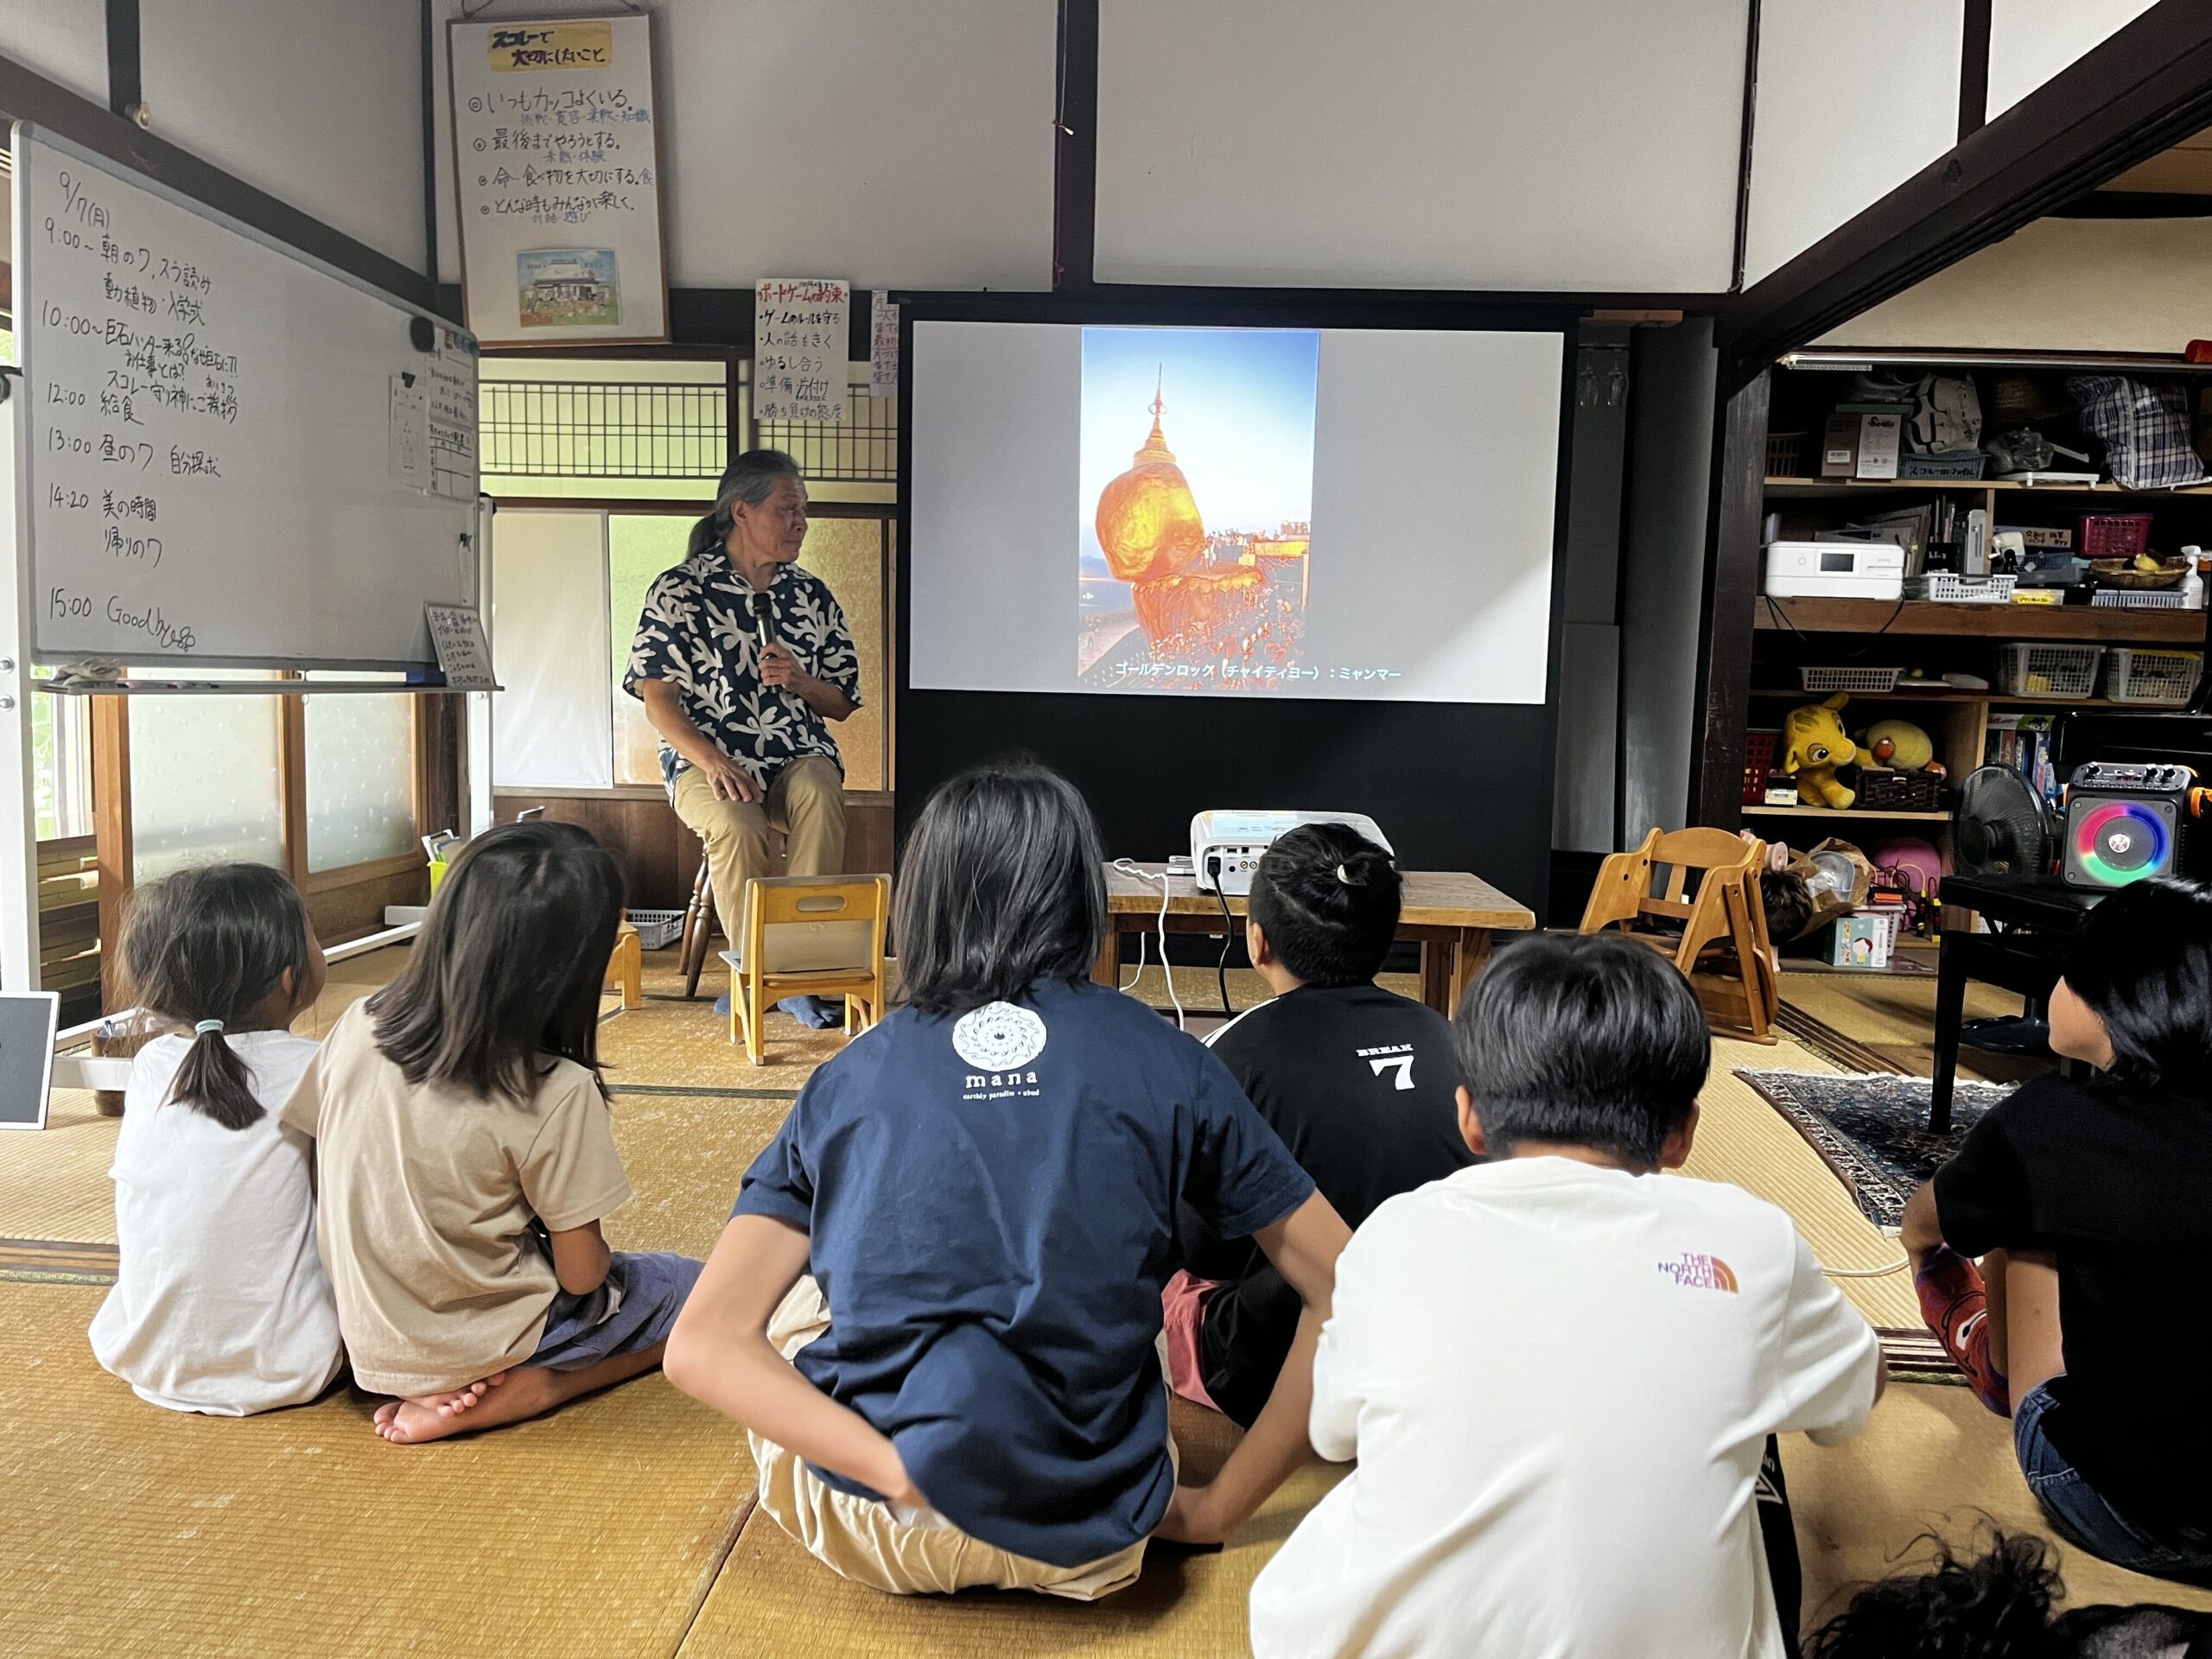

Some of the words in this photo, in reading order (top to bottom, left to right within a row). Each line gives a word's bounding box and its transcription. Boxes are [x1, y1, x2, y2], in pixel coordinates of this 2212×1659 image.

[511, 47, 605, 67] 大切にしたいこと
[493, 128, 620, 151] 最後までやろうとする。
[763, 331, 832, 350] 人の話をきく
[765, 355, 824, 373] ゆるし合う
[48, 382, 86, 405] 12:00
[100, 390, 145, 425] 給食
[763, 402, 843, 421] 勝ち負けの態度
[48, 426, 92, 454] 13:00
[49, 482, 89, 509] 14:20
[102, 489, 157, 523] 美の時間
[50, 587, 92, 620] 15:00
[1355, 1043, 1414, 1057] BREAK
[965, 1071, 1038, 1089] mana
[1369, 1055, 1415, 1090] 7
[963, 1092, 987, 1101] earthly
[1681, 1252, 1708, 1267] THE
[1657, 1262, 1713, 1279] NORTH
[1675, 1272, 1713, 1289] FACE
